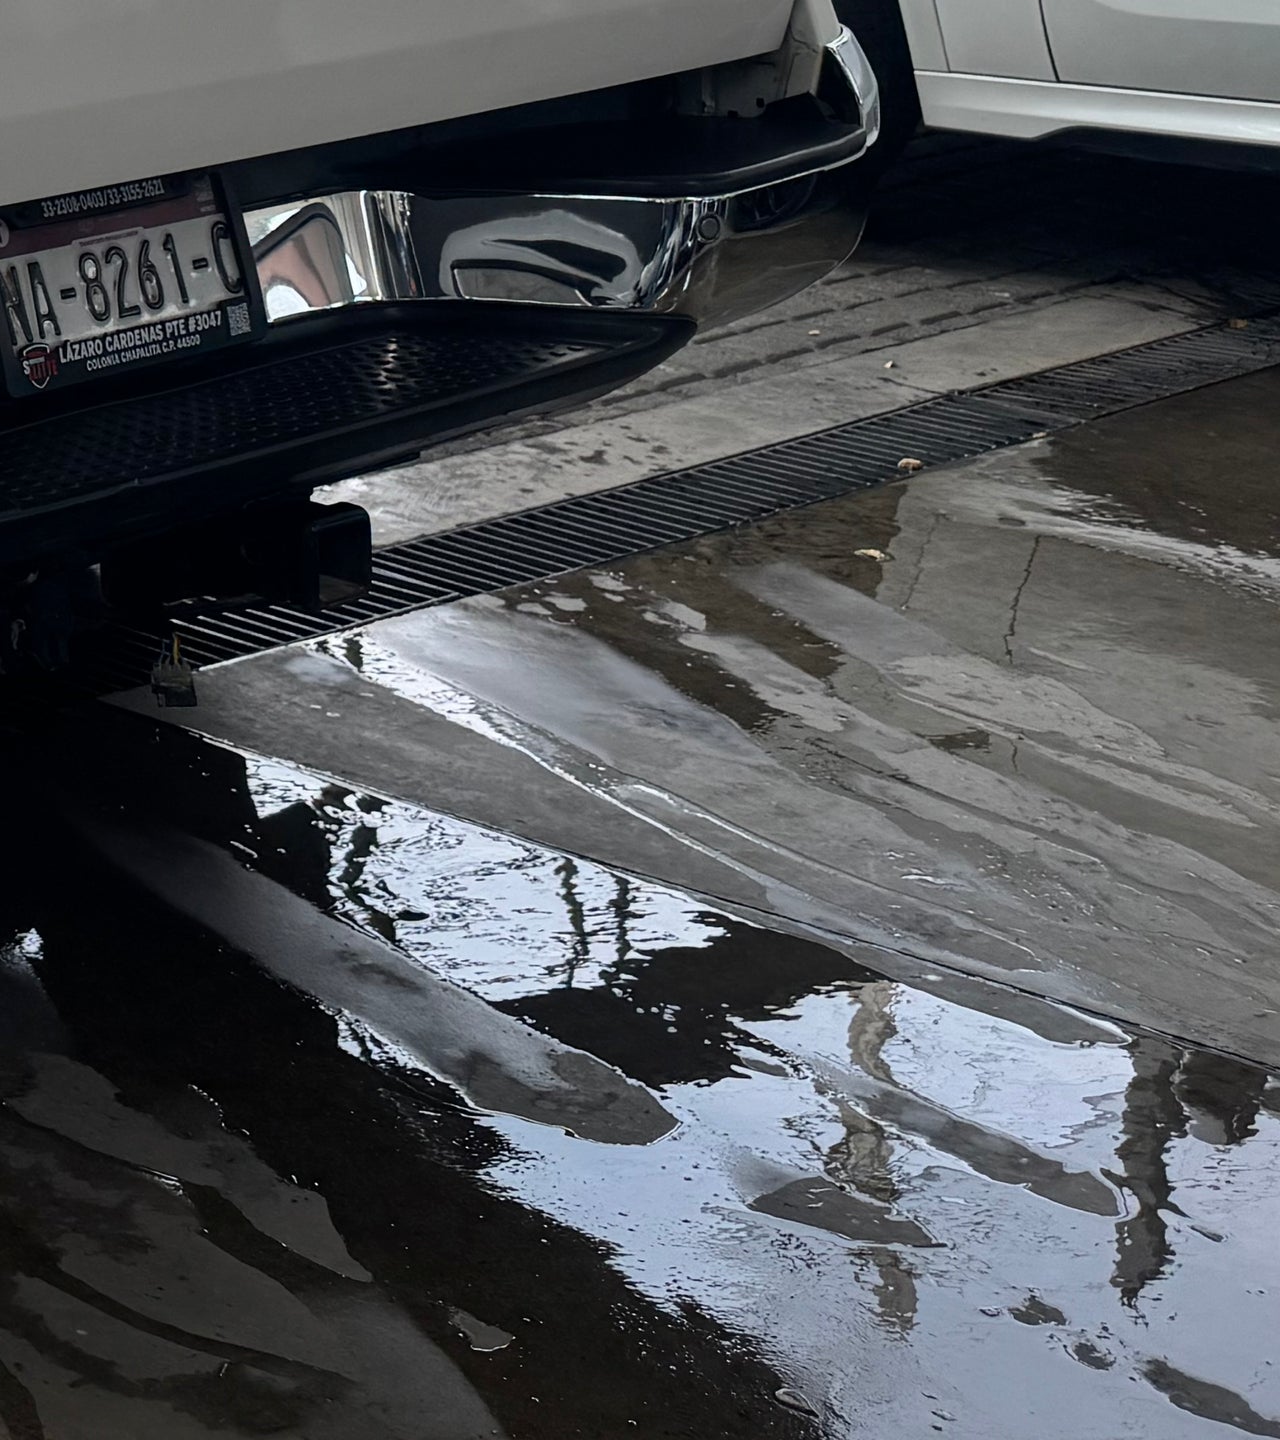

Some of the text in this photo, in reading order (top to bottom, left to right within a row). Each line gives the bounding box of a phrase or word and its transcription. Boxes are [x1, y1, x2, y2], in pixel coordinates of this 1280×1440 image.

[105, 325, 164, 353] CARDENAS
[165, 319, 186, 338] PTE
[188, 311, 222, 333] #3047
[86, 354, 120, 371] COLONIA
[120, 344, 162, 364] CHAPALITA
